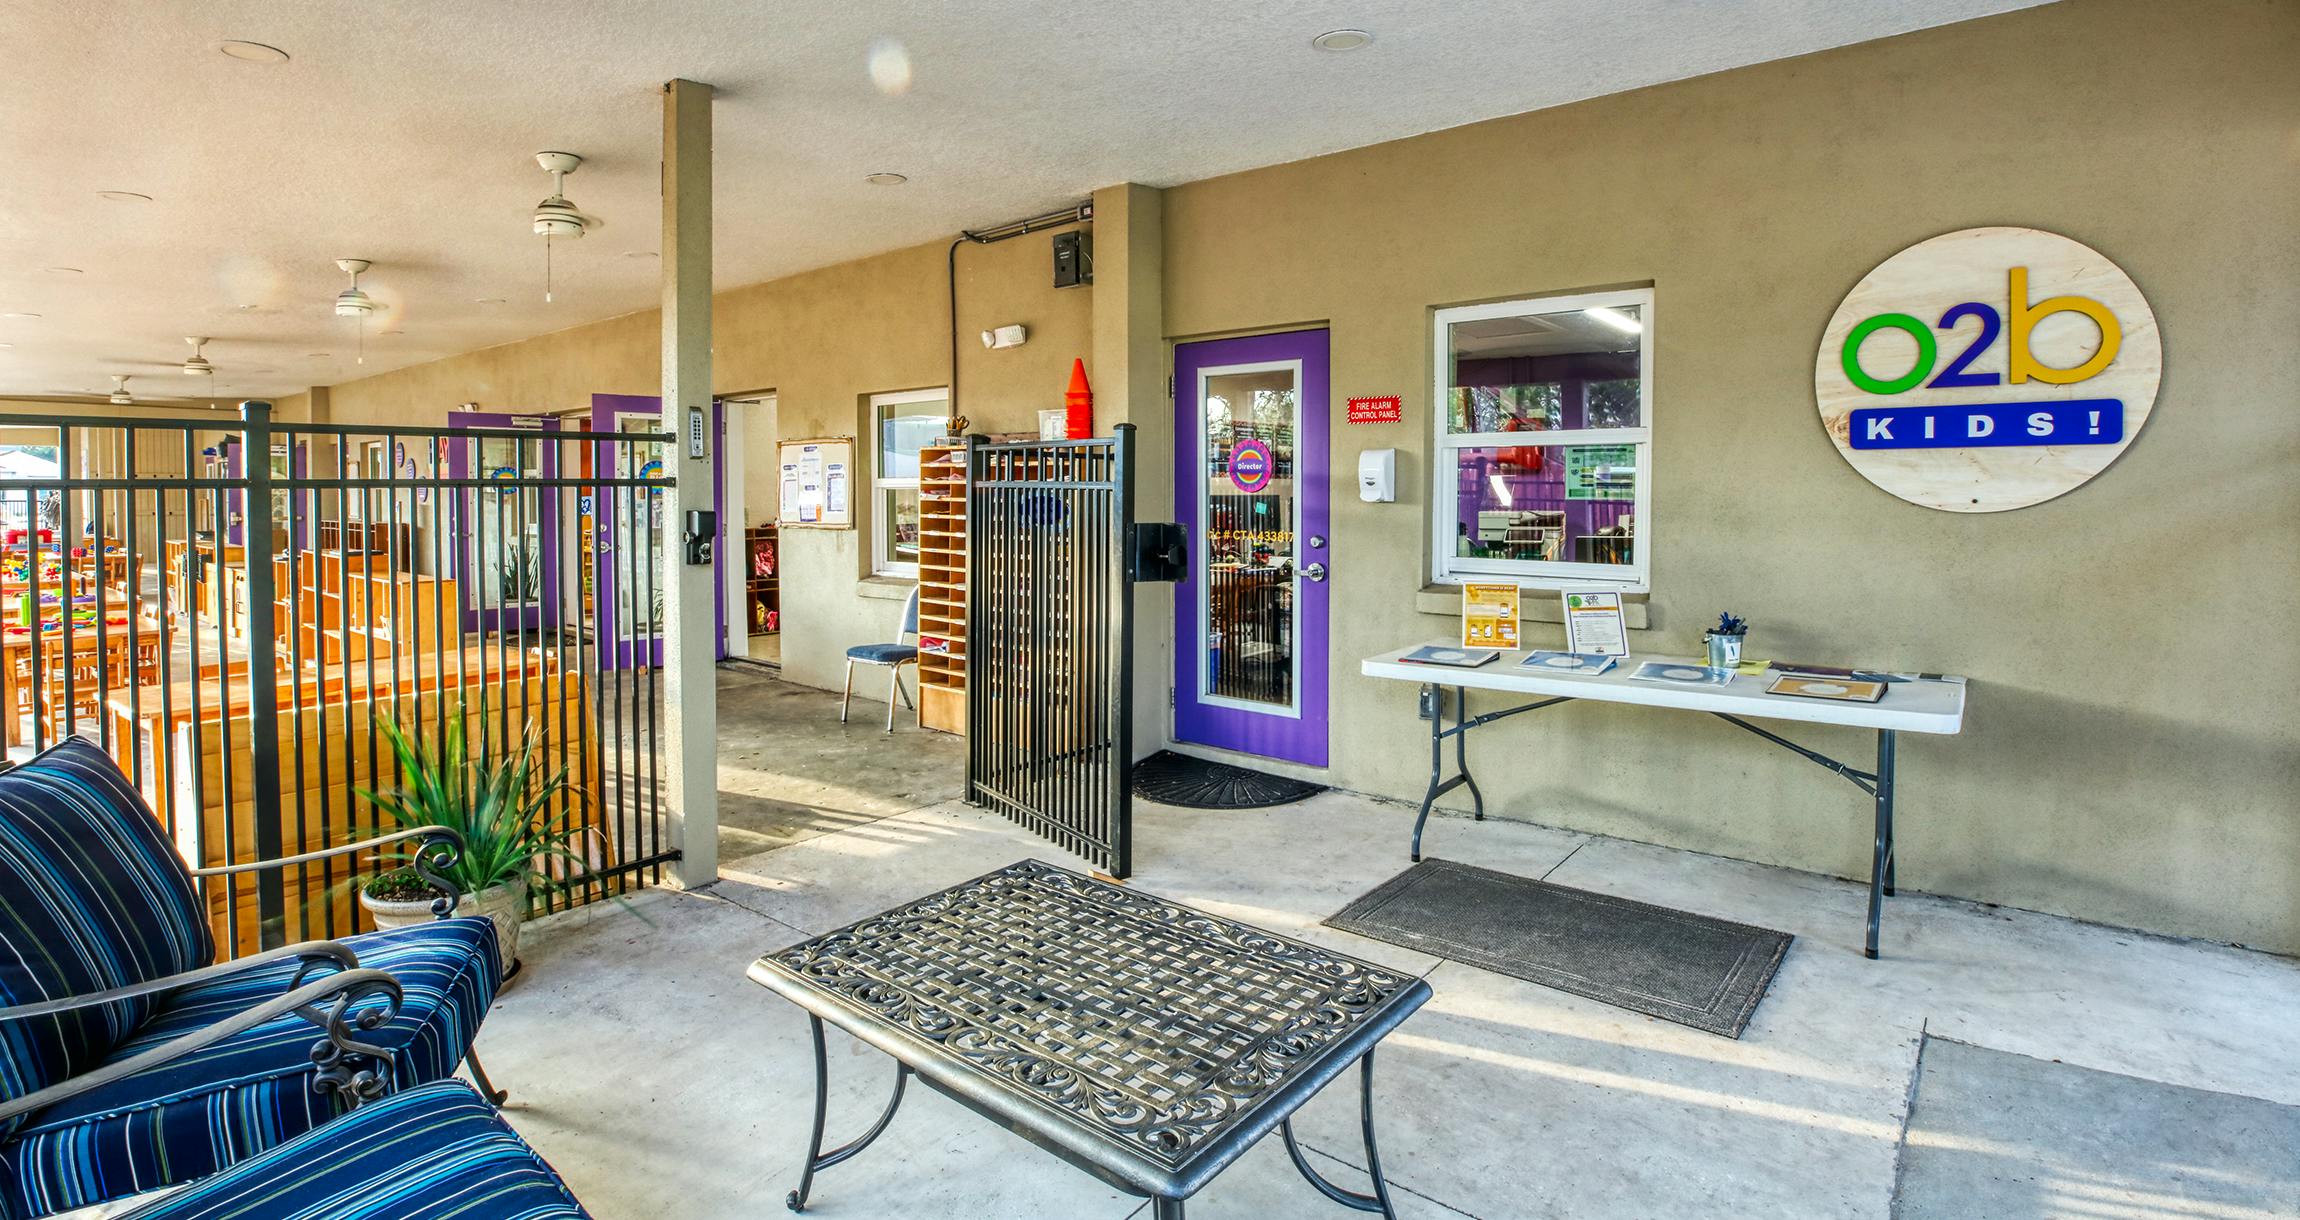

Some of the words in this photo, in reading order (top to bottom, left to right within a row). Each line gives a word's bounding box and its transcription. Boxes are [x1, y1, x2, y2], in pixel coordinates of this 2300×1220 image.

[1841, 266, 2123, 395] o2b
[1356, 402, 1370, 410] FIRE
[1371, 401, 1392, 410] ALARM
[1350, 411, 1378, 420] CONTROL
[1378, 410, 1398, 419] PANEL
[1867, 410, 2100, 441] KIDS!
[1237, 462, 1263, 470] Director
[1232, 530, 1255, 541] CTA
[1257, 531, 1295, 543] 433817
